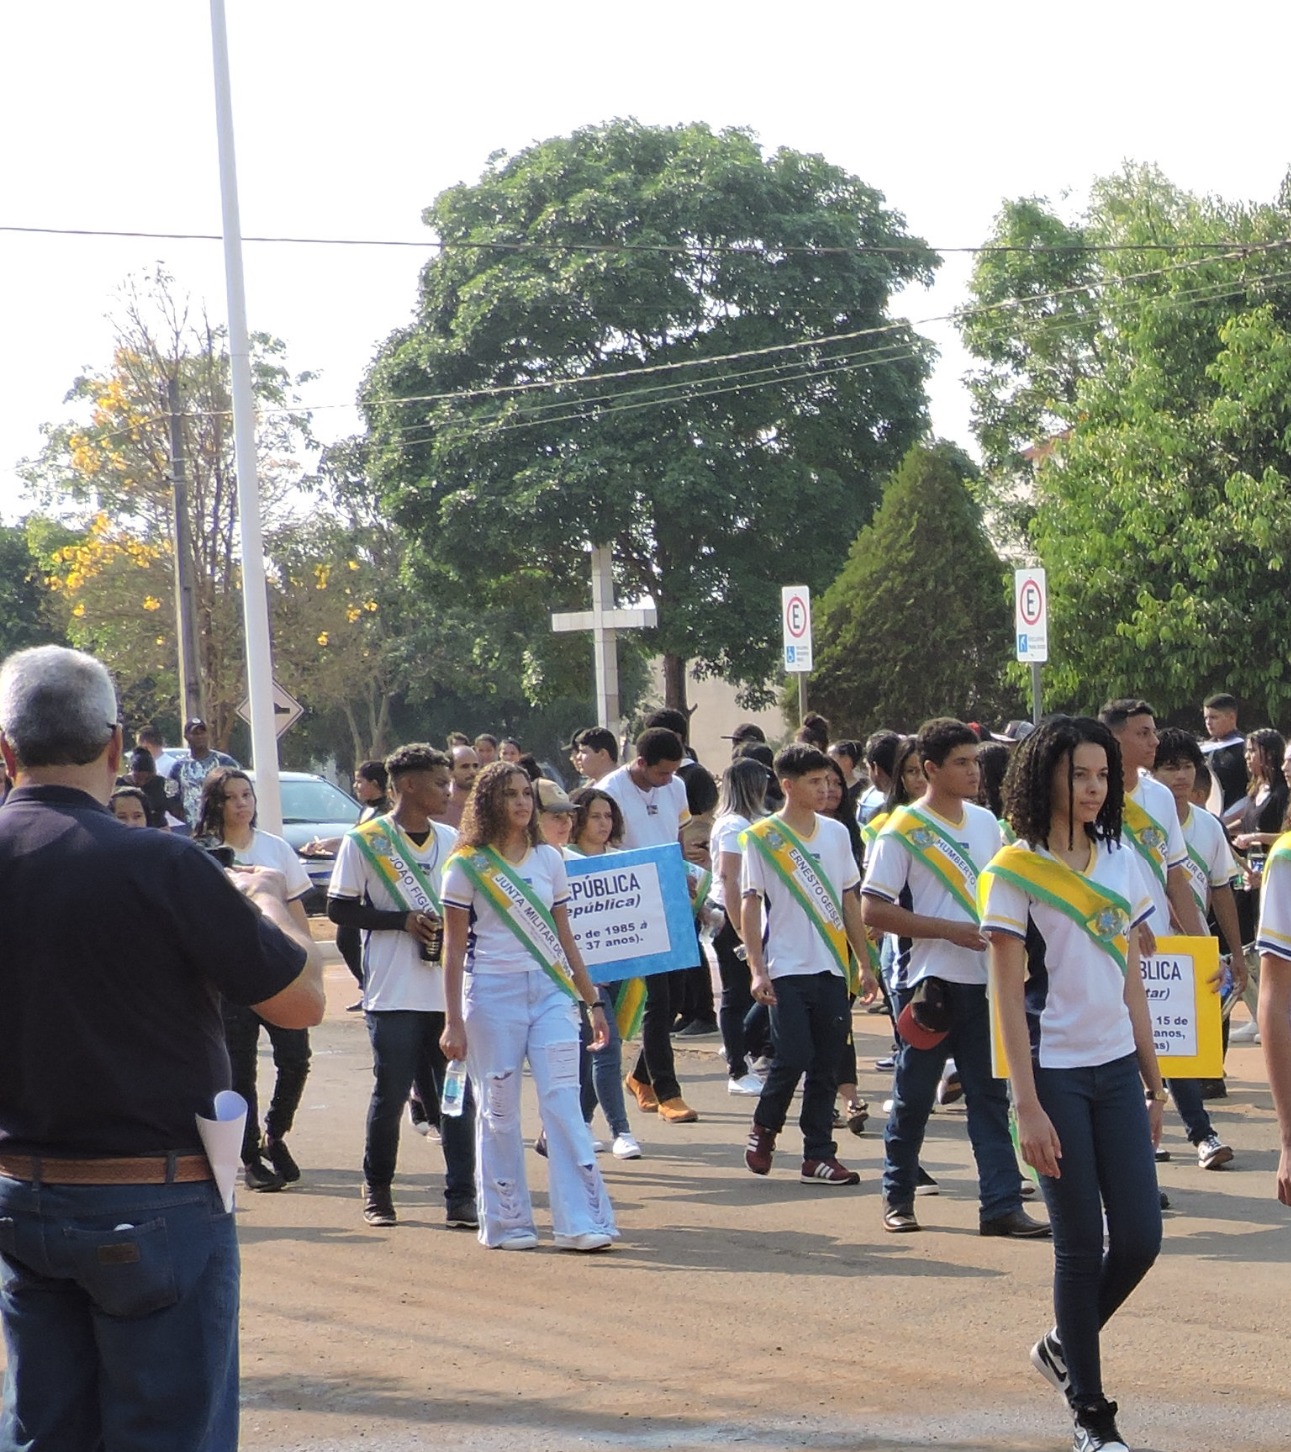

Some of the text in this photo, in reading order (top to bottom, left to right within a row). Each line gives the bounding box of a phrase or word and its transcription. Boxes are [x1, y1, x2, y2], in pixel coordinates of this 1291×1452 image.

[1026, 589, 1036, 616] E
[792, 604, 801, 630] E
[936, 838, 977, 886] HUMBERTO
[570, 872, 642, 902] PÚBLICA
[788, 848, 824, 896] ERNESTO
[821, 895, 842, 931] GEISEL
[495, 875, 525, 908] JUNTA
[524, 906, 556, 945] MILITAR
[567, 893, 642, 919] epública)
[585, 929, 601, 939] de
[604, 922, 636, 936] 1985
[585, 939, 601, 951] 37
[605, 933, 645, 948] anos).
[1139, 960, 1182, 981] BLICA
[1145, 987, 1171, 1001] tar)
[1156, 1015, 1189, 1026] 15 de
[1154, 1029, 1186, 1040] anos,
